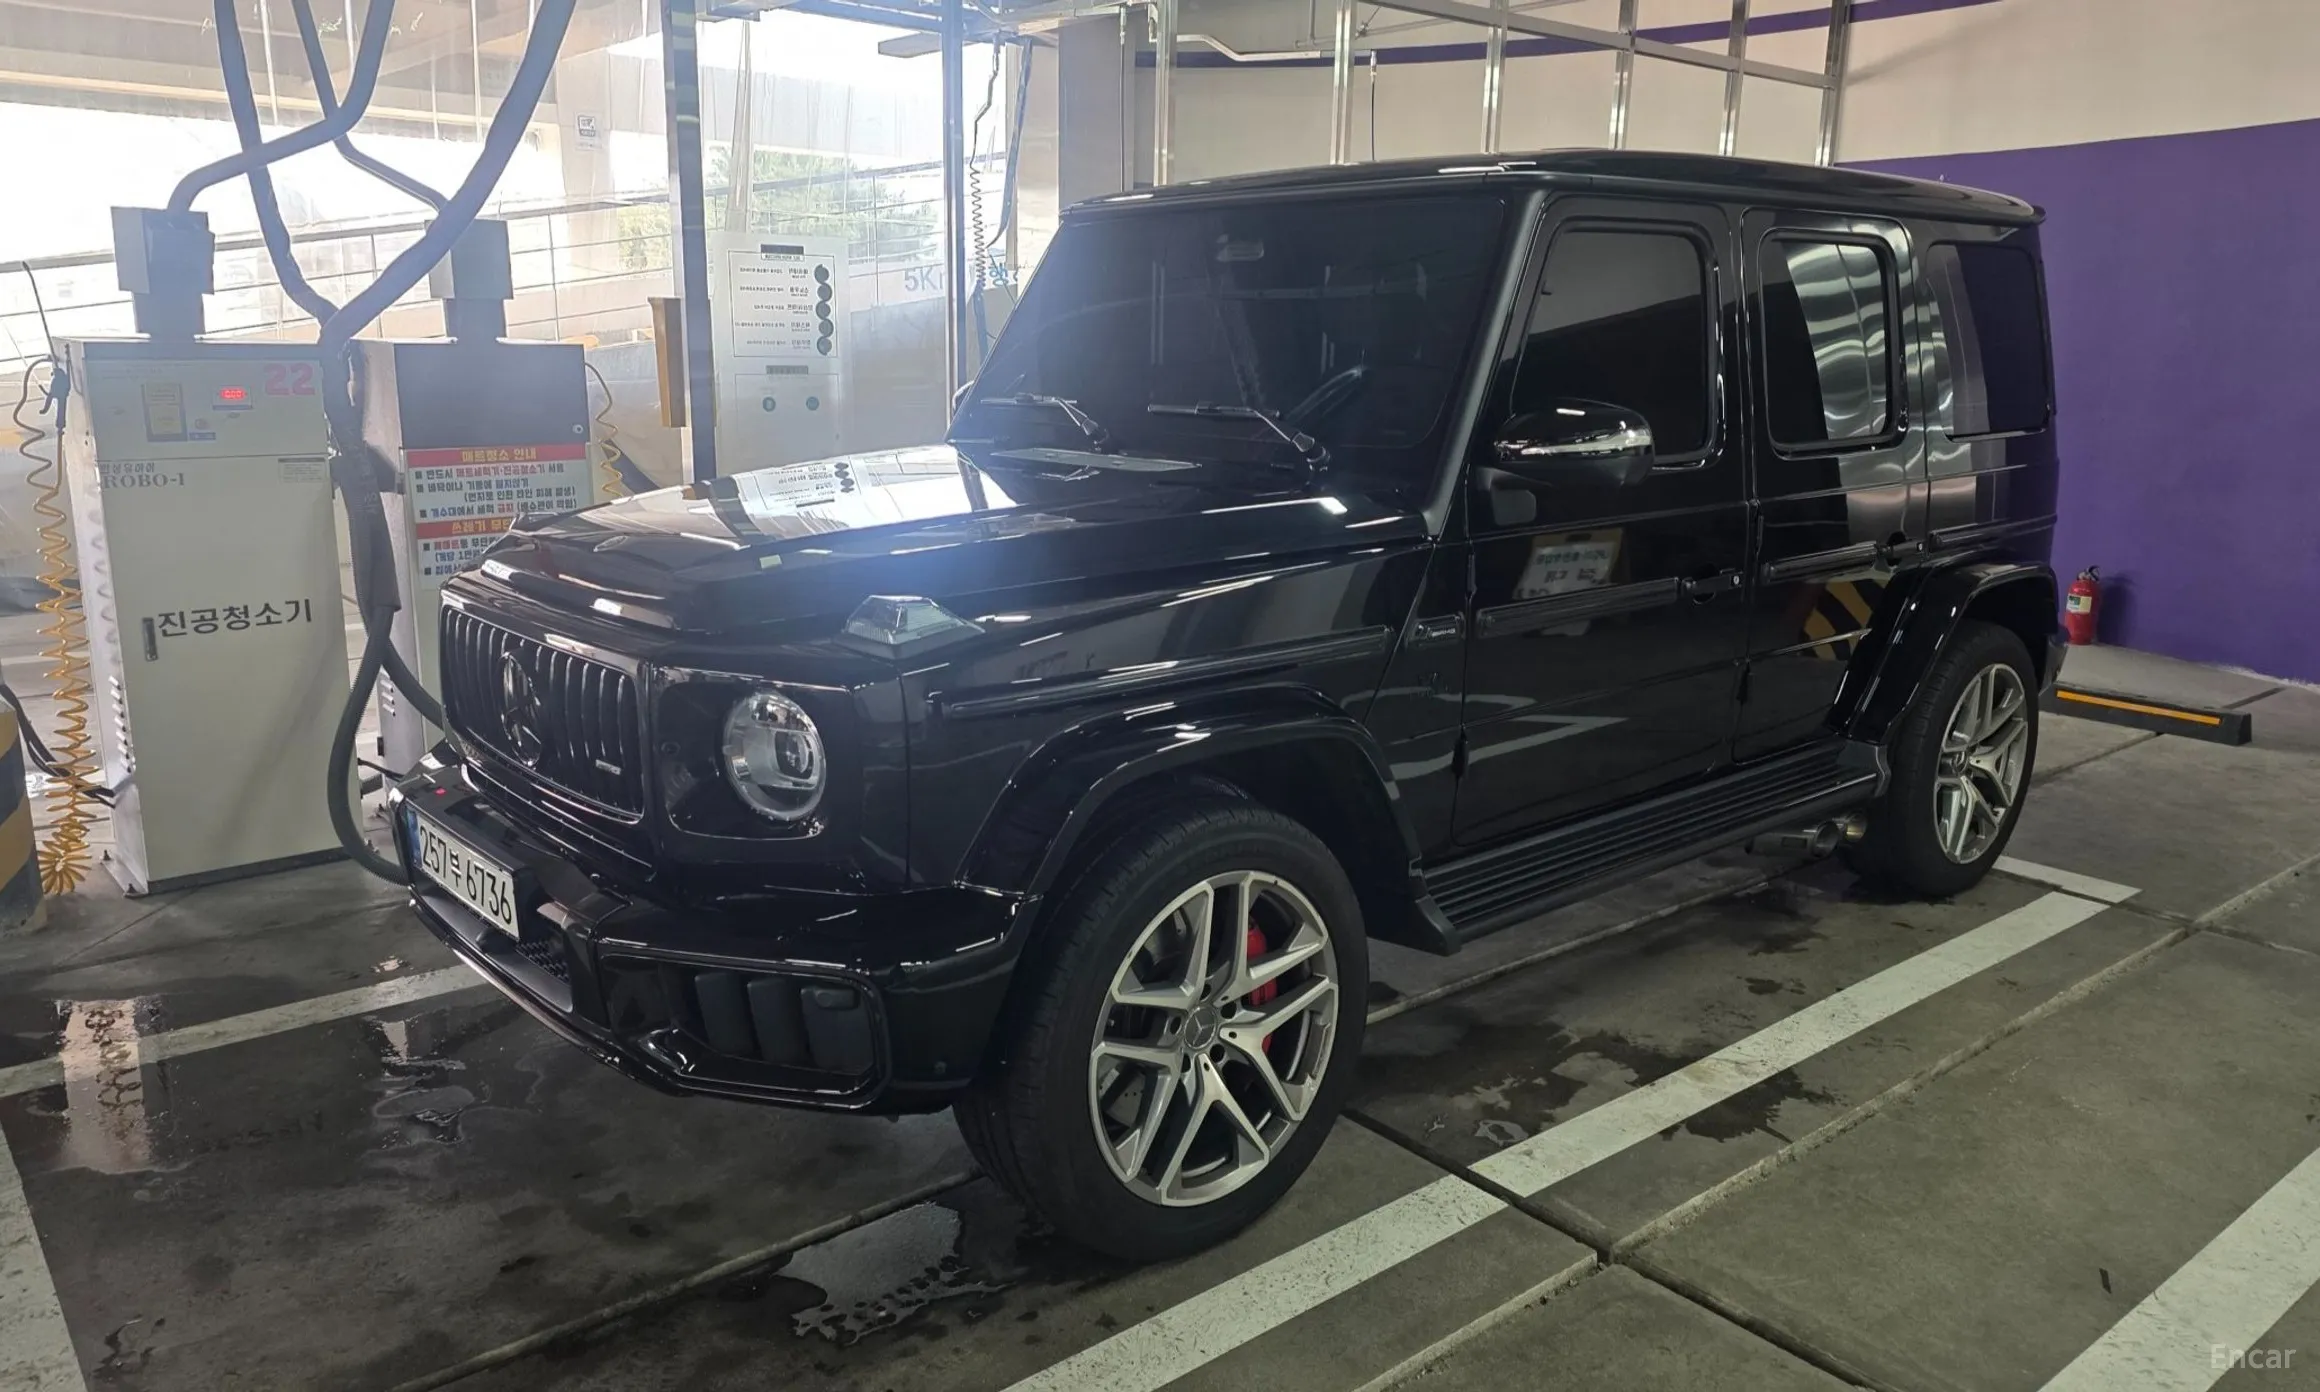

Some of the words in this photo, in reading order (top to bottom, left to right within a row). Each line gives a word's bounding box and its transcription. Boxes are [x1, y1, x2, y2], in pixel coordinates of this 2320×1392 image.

[264, 362, 316, 396] 22
[462, 449, 510, 463] 매트청소
[515, 448, 537, 460] 안내
[451, 519, 486, 534] 쓰레기
[158, 598, 312, 638] 진공청소기
